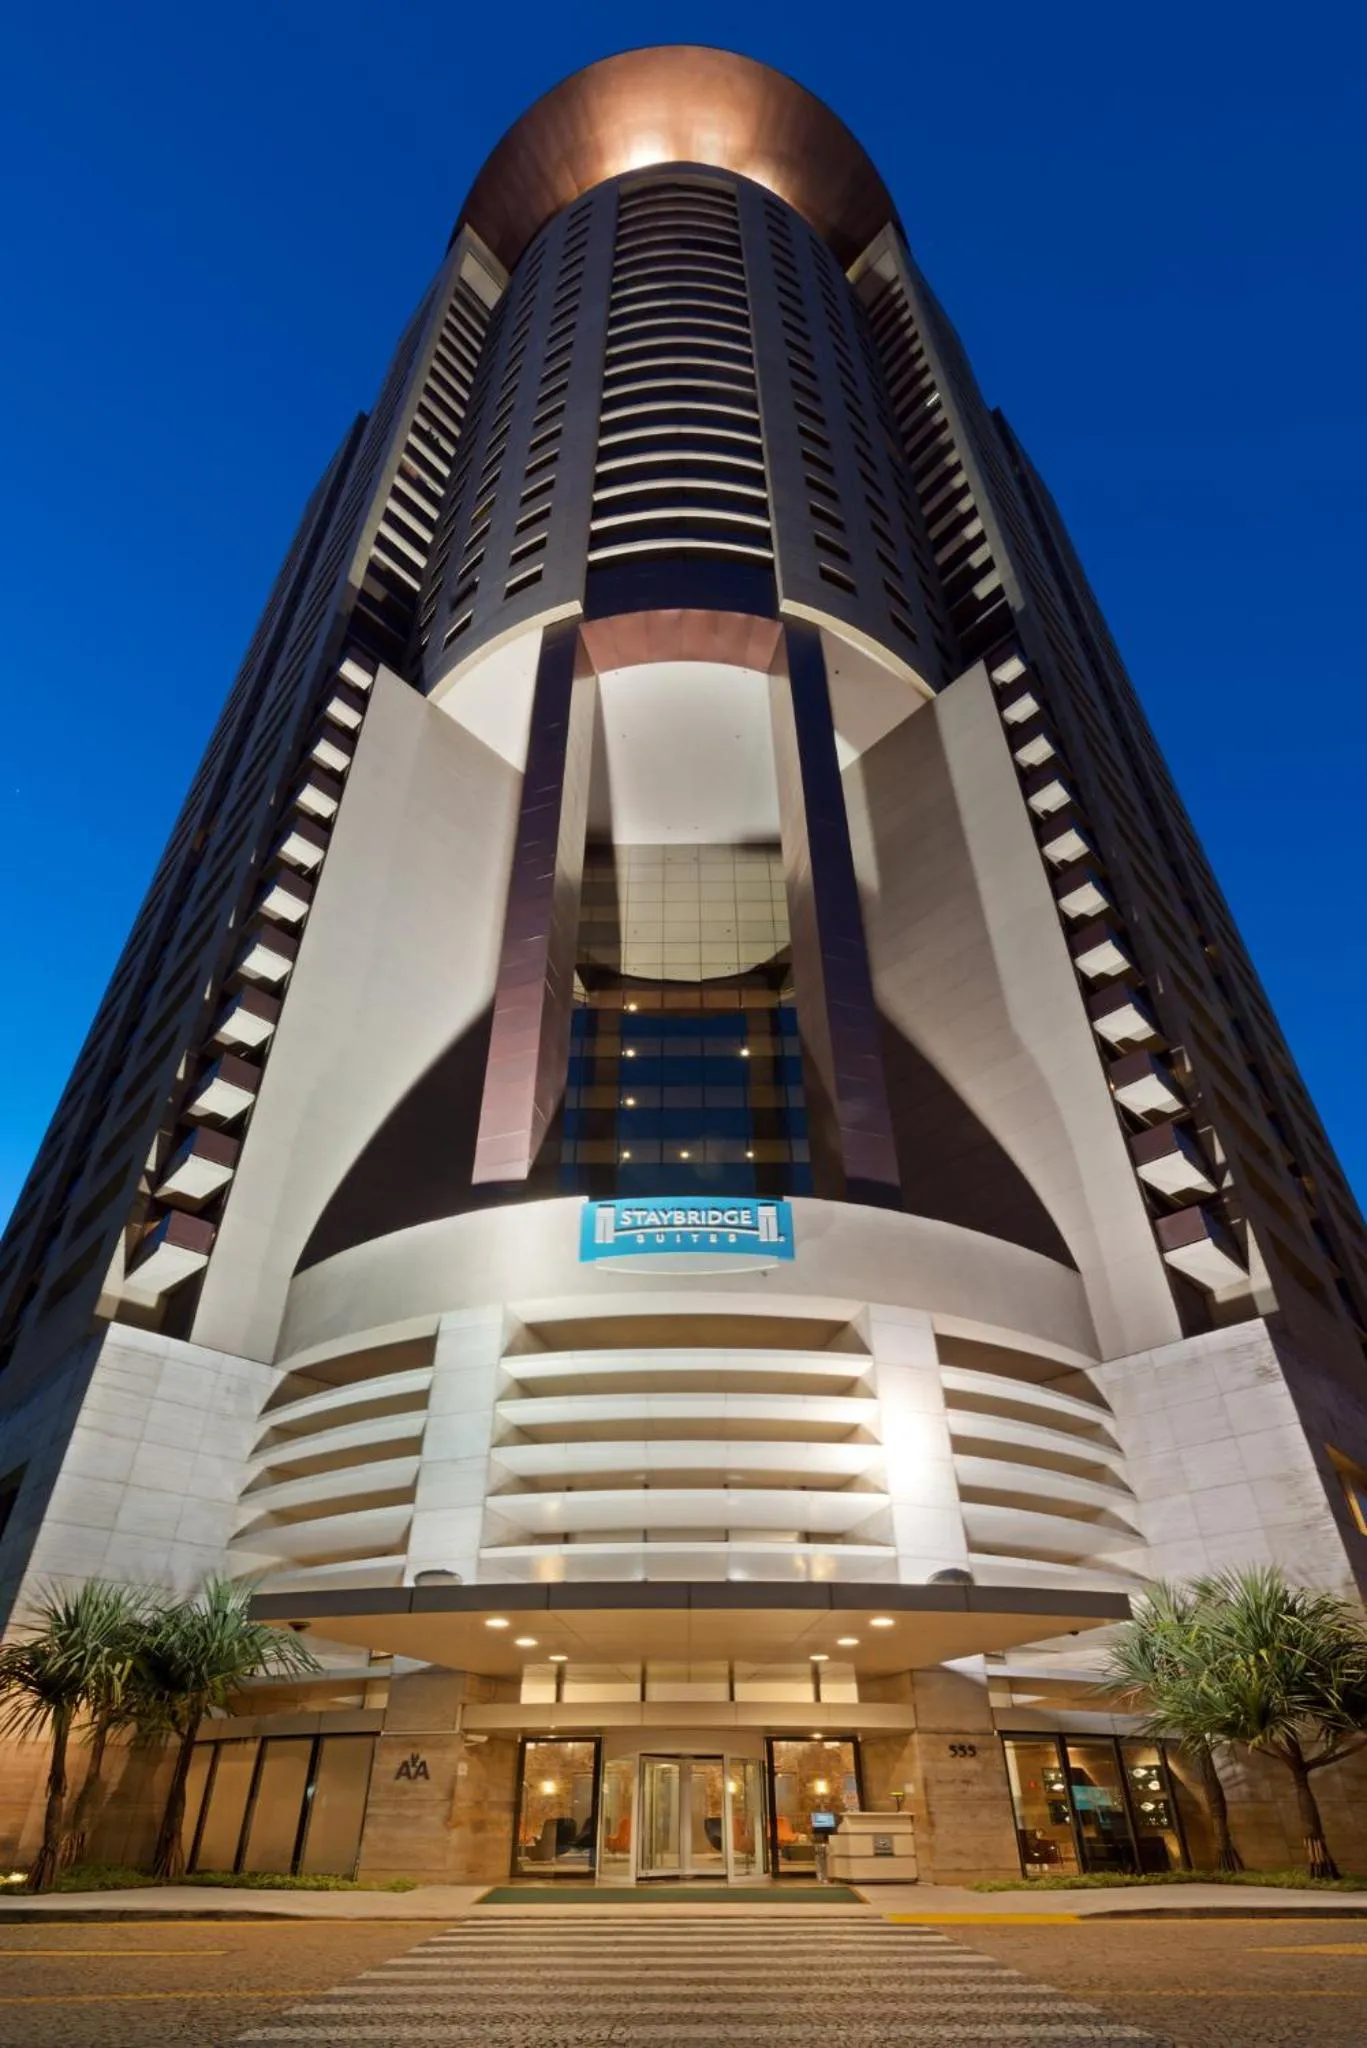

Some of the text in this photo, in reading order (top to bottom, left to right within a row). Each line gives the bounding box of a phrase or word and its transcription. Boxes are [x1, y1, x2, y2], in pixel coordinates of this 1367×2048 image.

[620, 1210, 752, 1225] STAYBRIDGE
[636, 1233, 737, 1243] SUITES
[948, 1744, 977, 1758] 555
